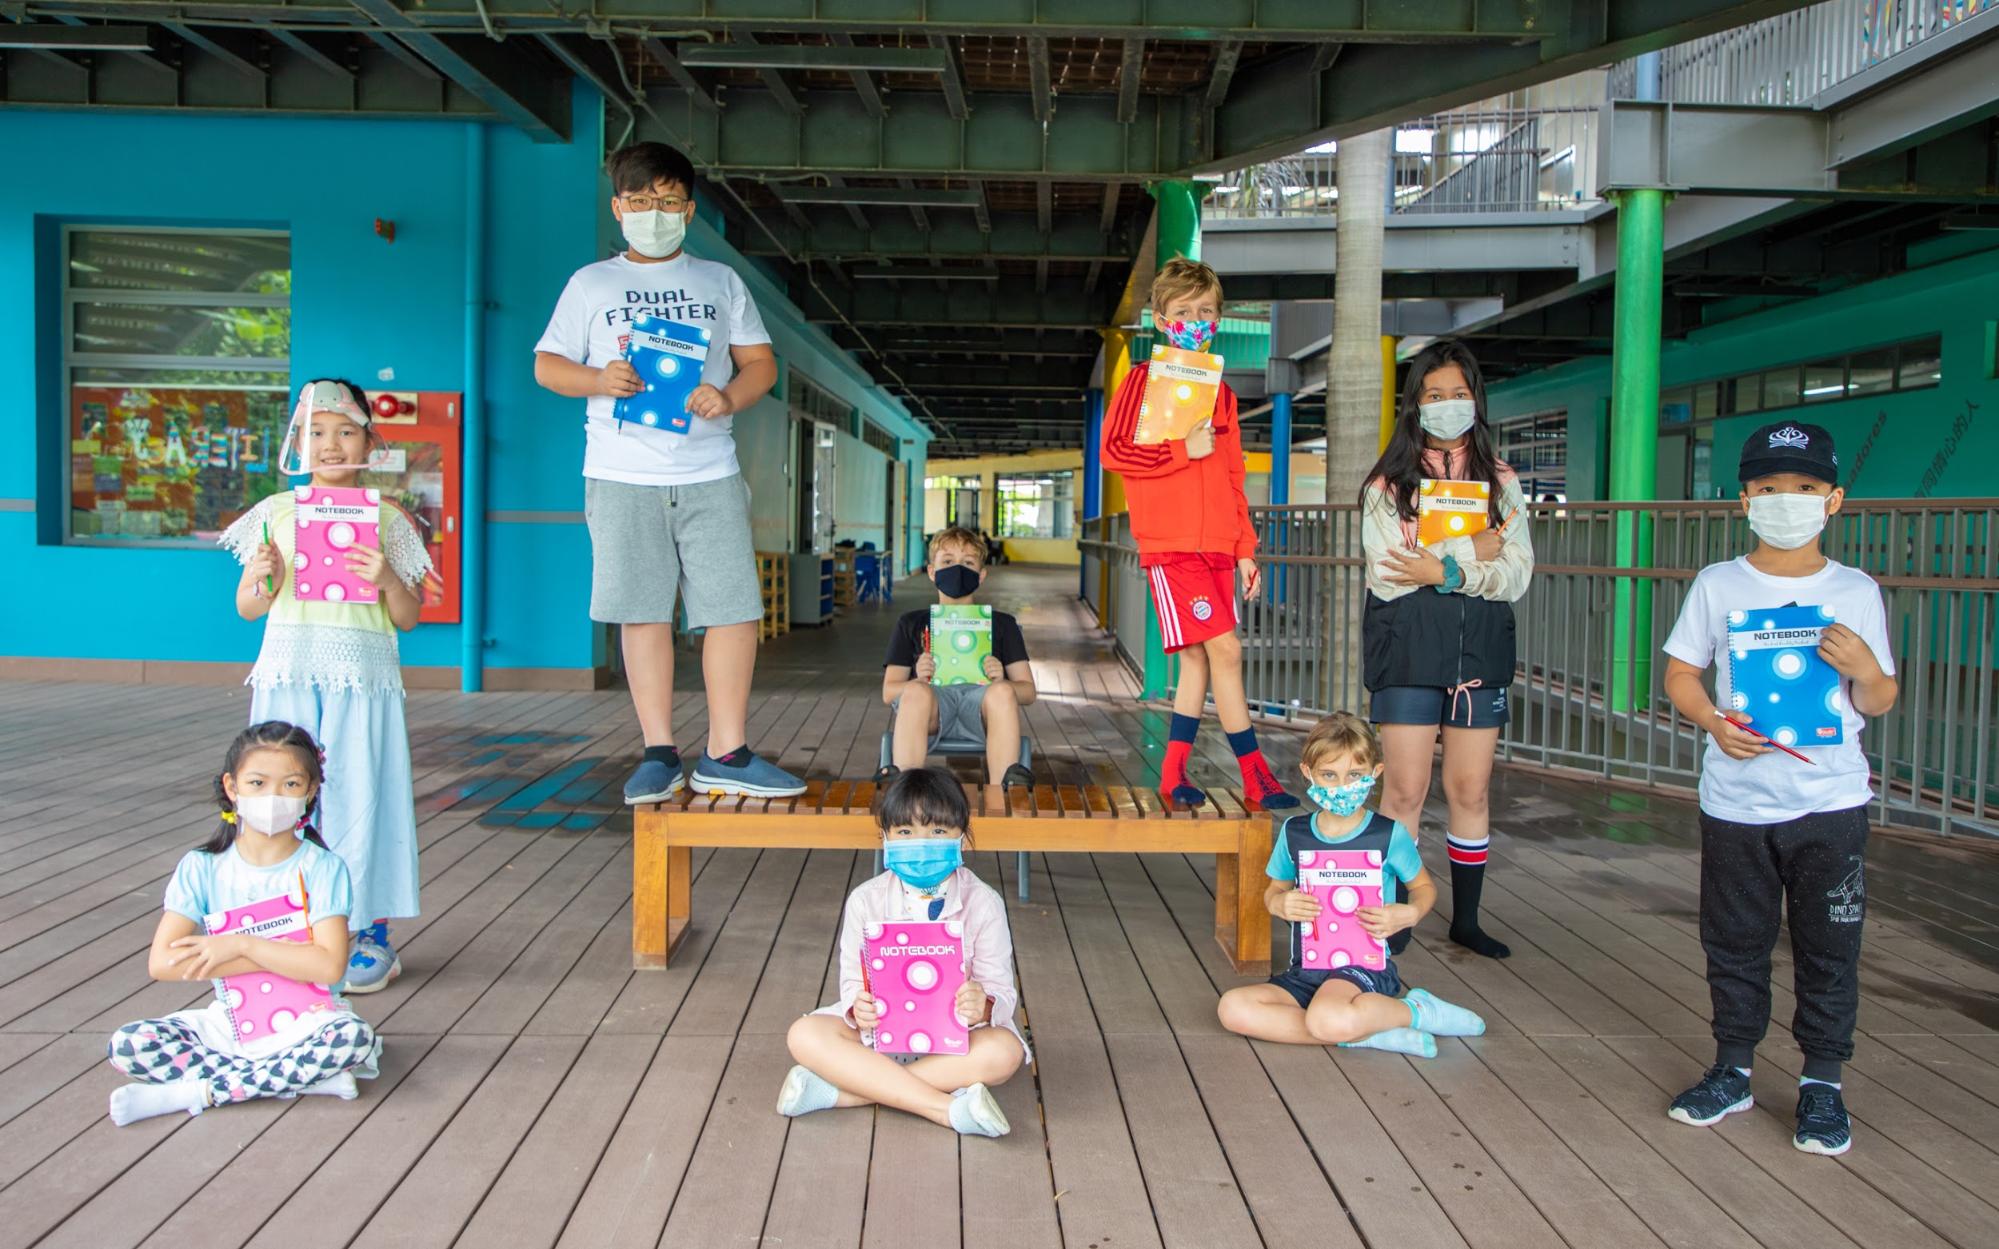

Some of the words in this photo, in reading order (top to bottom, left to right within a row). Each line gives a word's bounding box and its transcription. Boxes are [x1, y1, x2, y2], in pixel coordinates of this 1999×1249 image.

[625, 288, 694, 305] DUAL
[648, 335, 694, 352] NOTEBOOK
[1165, 364, 1208, 377] NOTEBOOK
[1435, 497, 1477, 506] NOTEBOOK
[314, 506, 365, 515] NOTEBOOK
[1753, 629, 1817, 640] NOTEBOOK
[1829, 904, 1847, 915] DINO
[235, 916, 293, 935] OTEBOOK
[879, 945, 956, 957] NOTEBOOK
